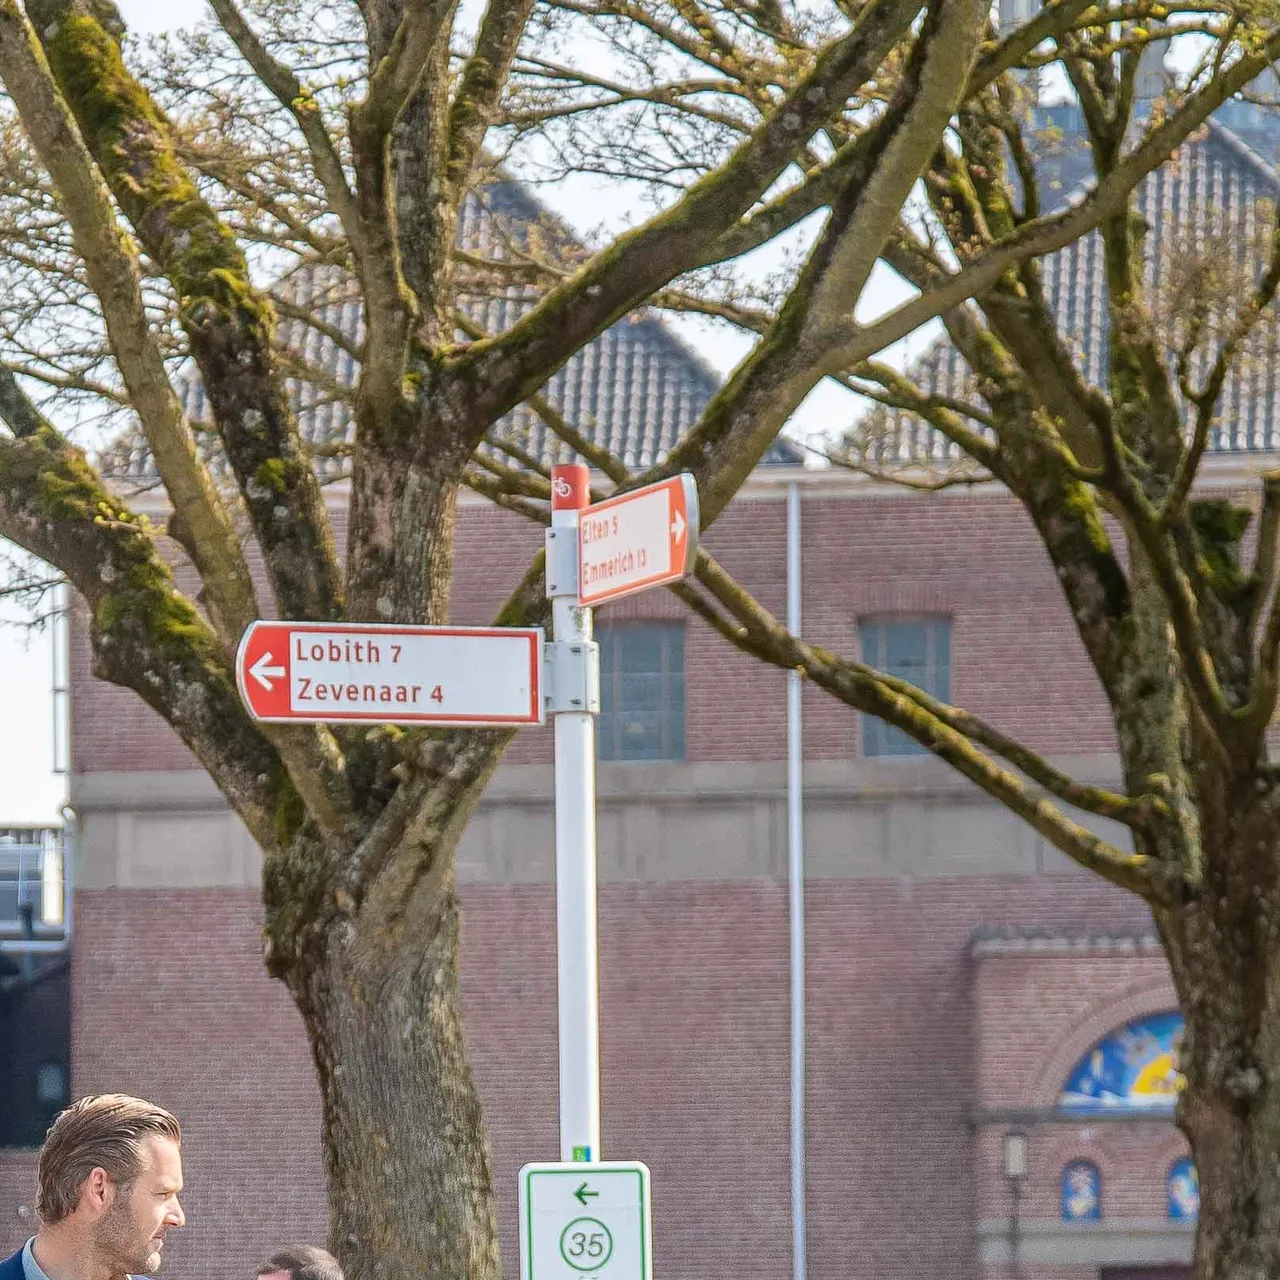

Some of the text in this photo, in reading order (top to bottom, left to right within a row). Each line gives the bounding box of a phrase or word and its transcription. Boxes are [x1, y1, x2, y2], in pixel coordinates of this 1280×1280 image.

[582, 519, 609, 544] Elten
[582, 548, 646, 585] Emmerich 13
[296, 638, 402, 663] Lobith 7
[297, 677, 444, 703] Zevenaar 4
[569, 1232, 603, 1257] 35
